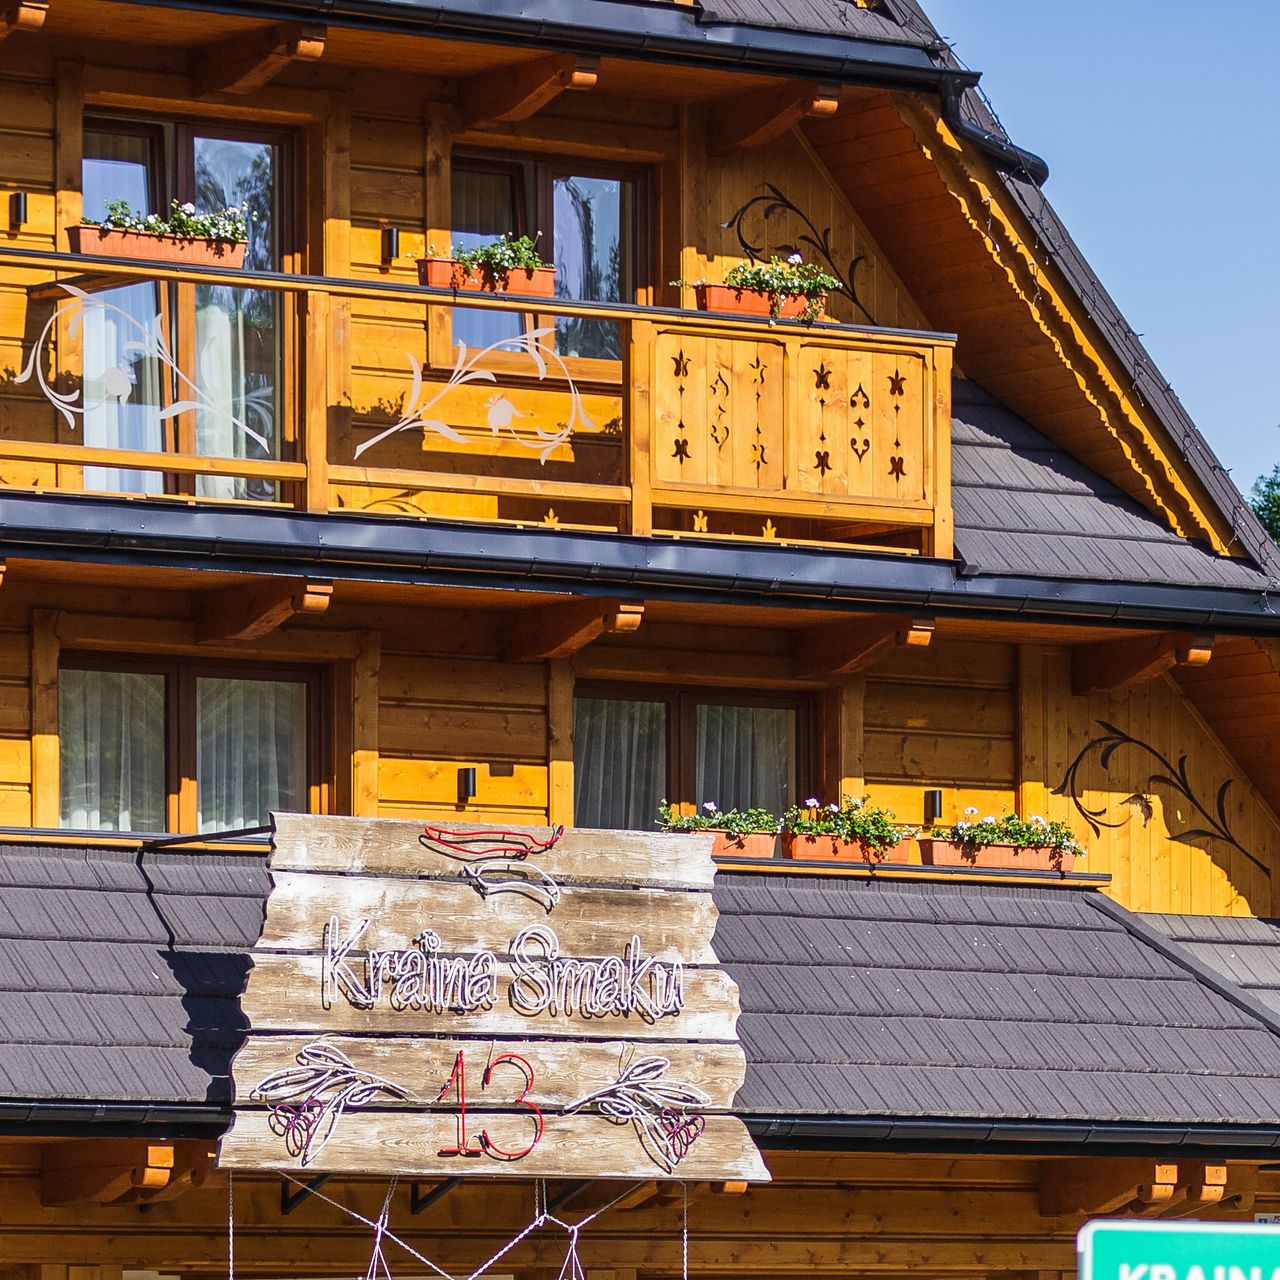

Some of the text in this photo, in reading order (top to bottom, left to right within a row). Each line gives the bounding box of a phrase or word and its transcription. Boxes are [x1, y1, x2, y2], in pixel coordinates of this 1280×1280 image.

[326, 914, 687, 1019] Kraina Smaku
[435, 1049, 545, 1159] 13
